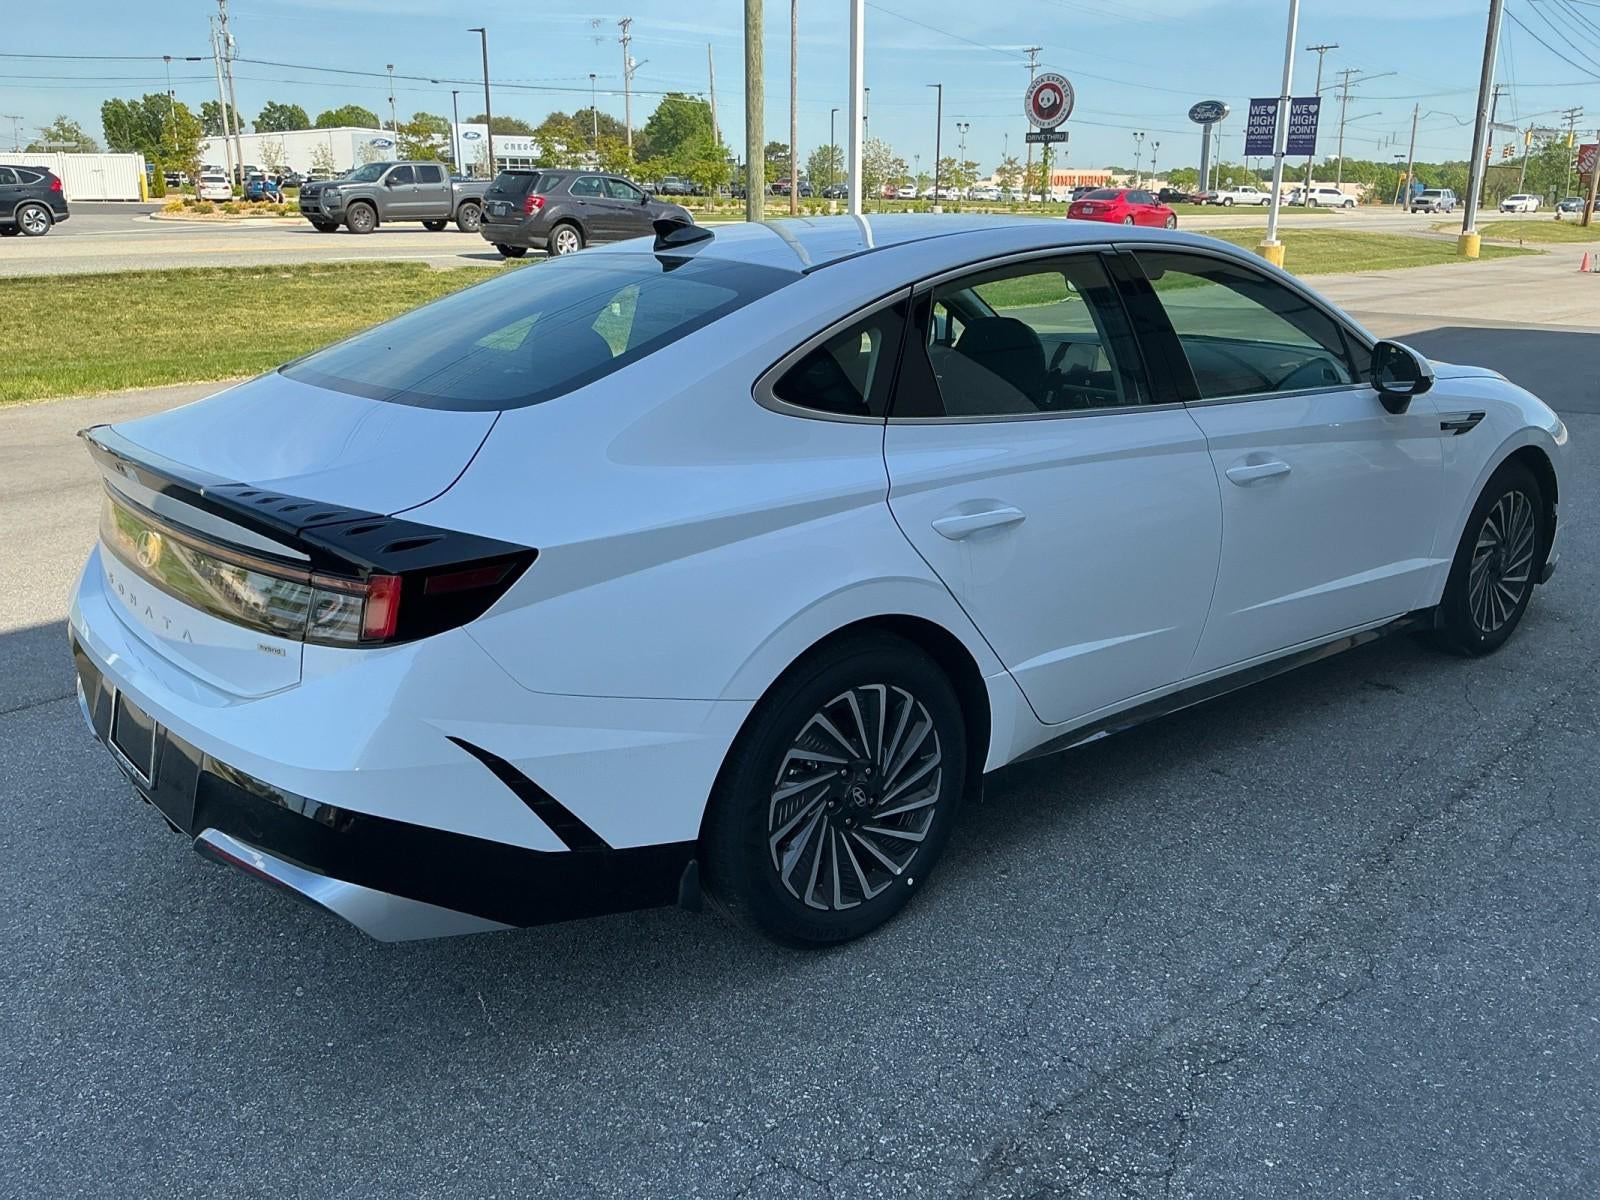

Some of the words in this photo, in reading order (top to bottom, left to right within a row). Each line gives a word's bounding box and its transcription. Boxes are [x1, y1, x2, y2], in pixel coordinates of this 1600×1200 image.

[1027, 77, 1045, 99] PANDA
[1047, 75, 1069, 98] EXPRESS
[1251, 105, 1267, 115] WE
[1292, 104, 1308, 114] WE
[1249, 115, 1275, 126] HIGH
[1290, 115, 1317, 125] HIGH
[1248, 126, 1274, 135] POINT
[1289, 125, 1316, 134] POINT
[1047, 133, 1065, 141] THRU
[109, 573, 194, 643] SONATA
